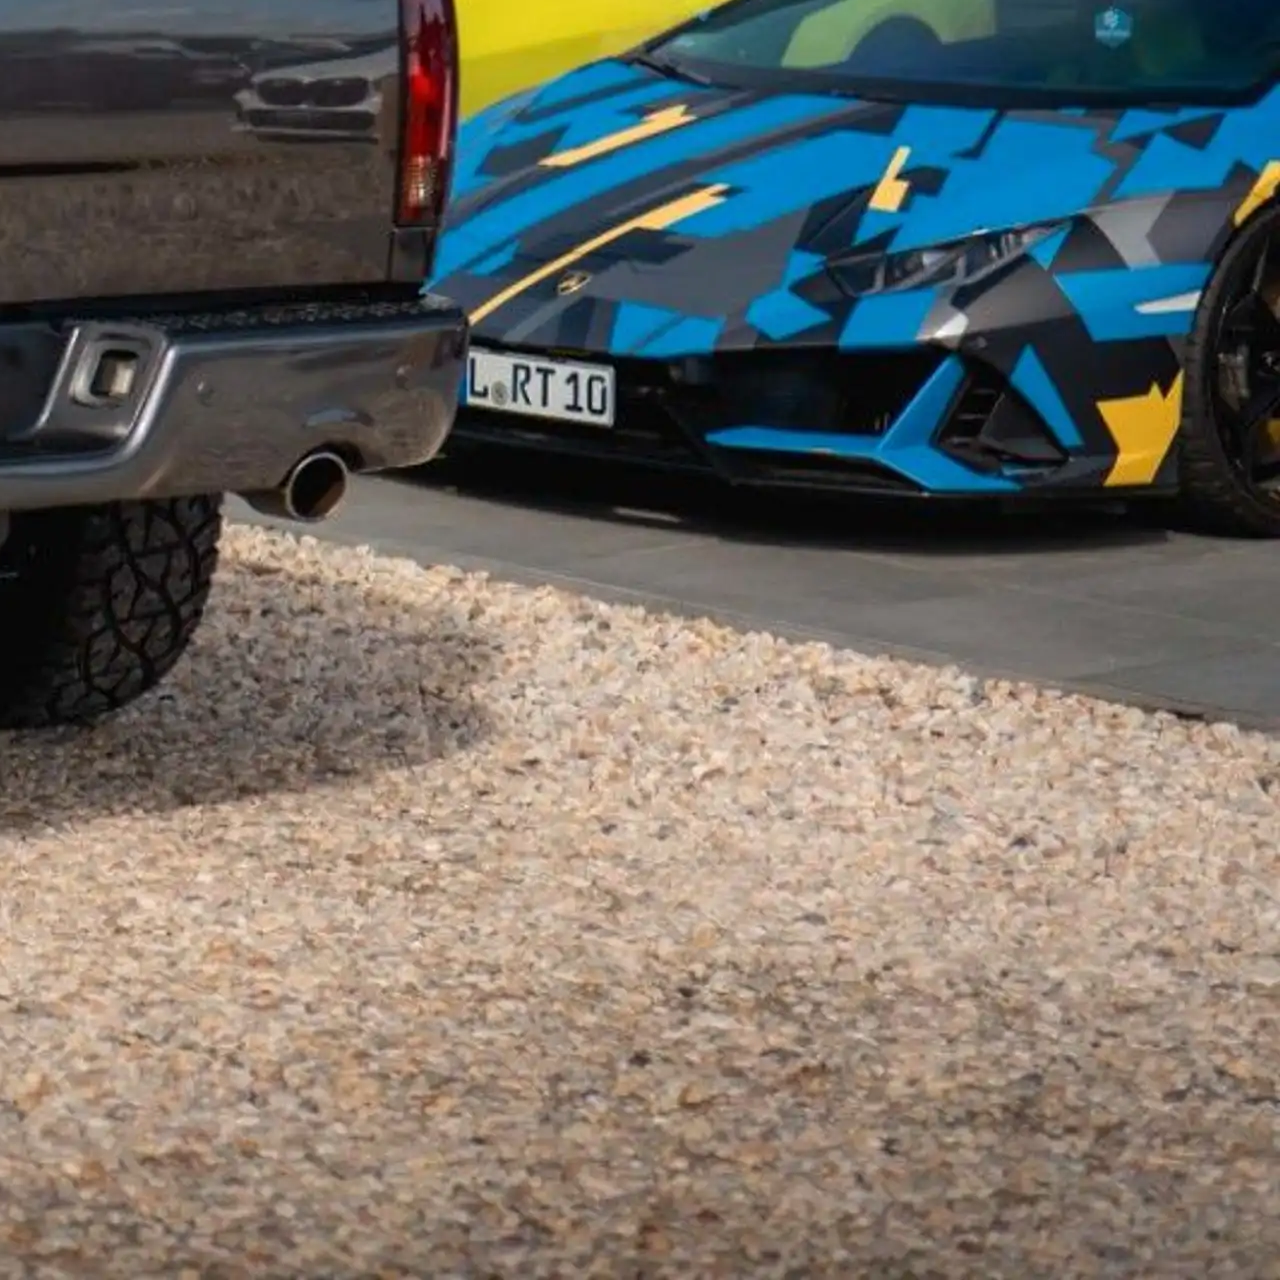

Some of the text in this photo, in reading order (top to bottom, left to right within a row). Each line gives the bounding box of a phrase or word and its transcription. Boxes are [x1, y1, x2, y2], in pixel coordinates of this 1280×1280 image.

[469, 357, 608, 415] L RT 10
